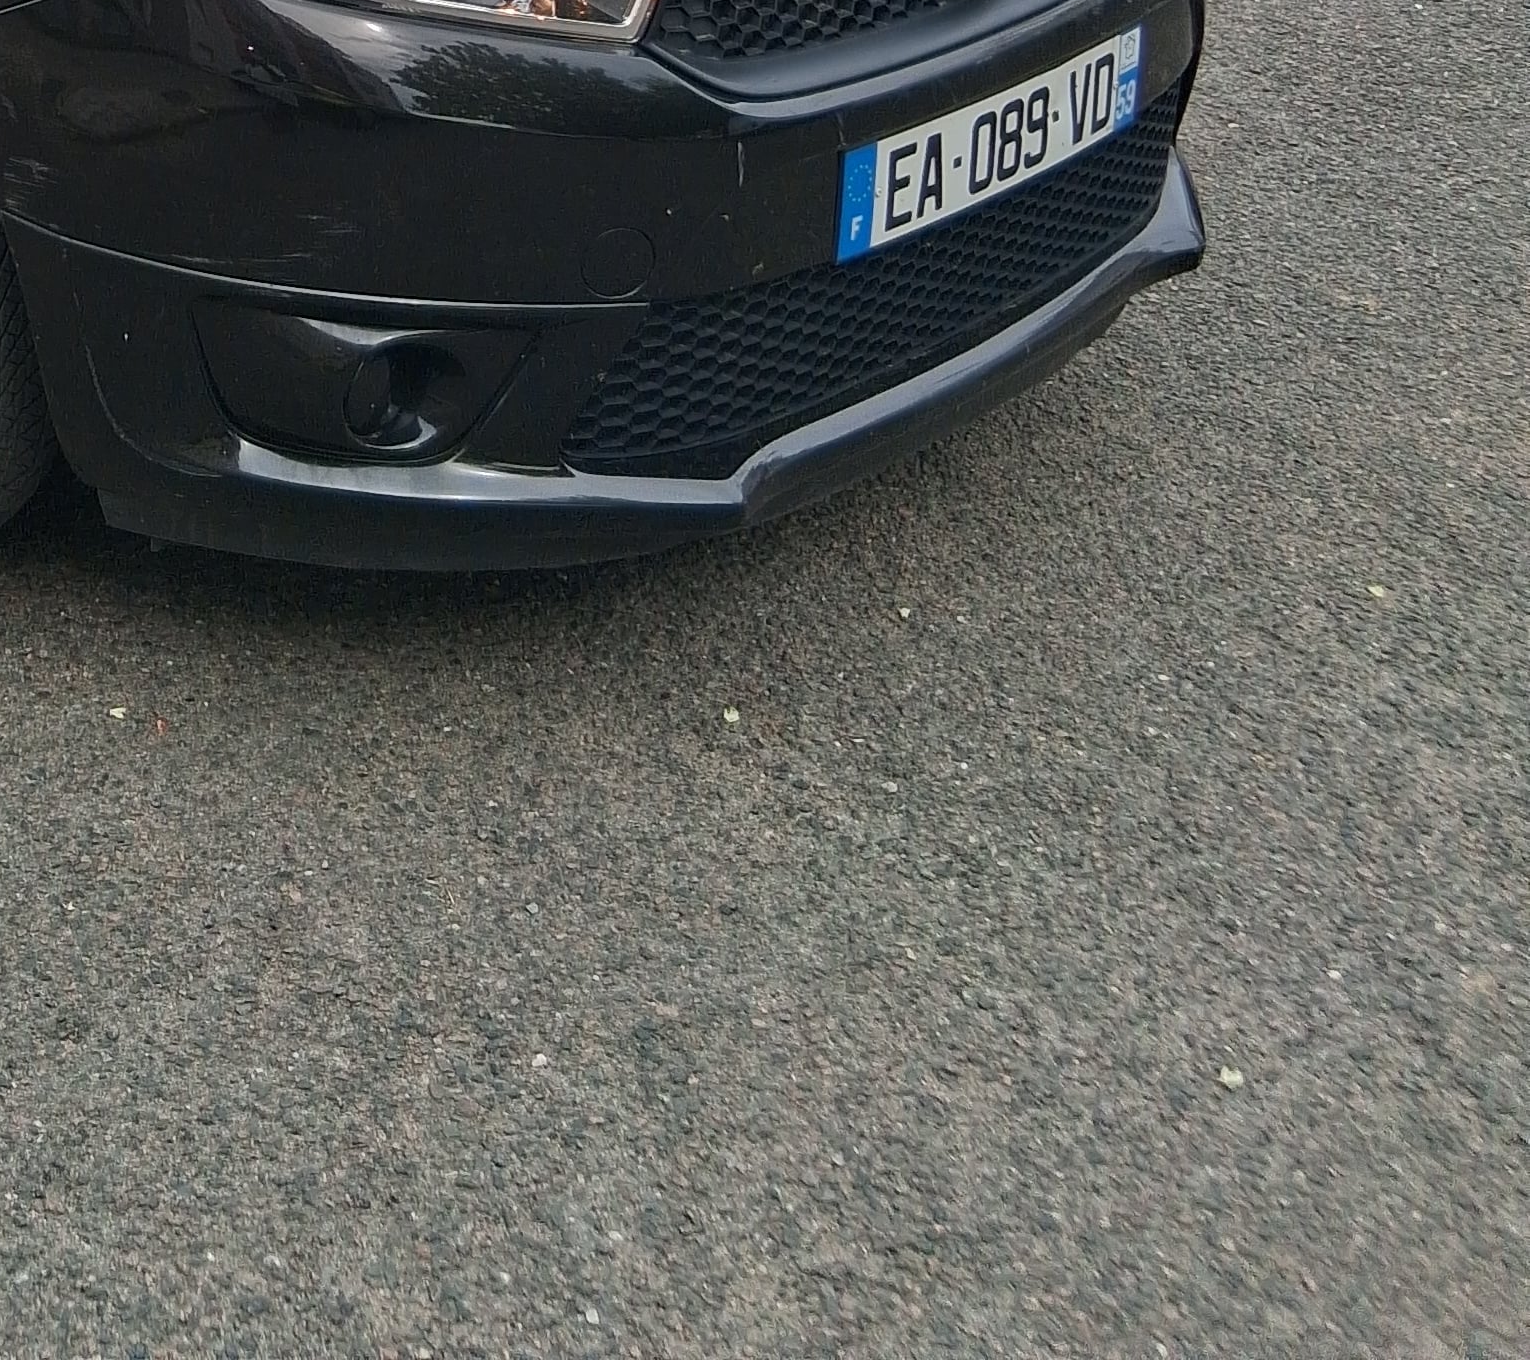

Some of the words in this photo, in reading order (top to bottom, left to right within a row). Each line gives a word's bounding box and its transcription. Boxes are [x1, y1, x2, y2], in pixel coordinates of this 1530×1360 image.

[850, 214, 865, 241] F
[884, 52, 1116, 233] EA-089-VD
[1116, 78, 1137, 121] 59
